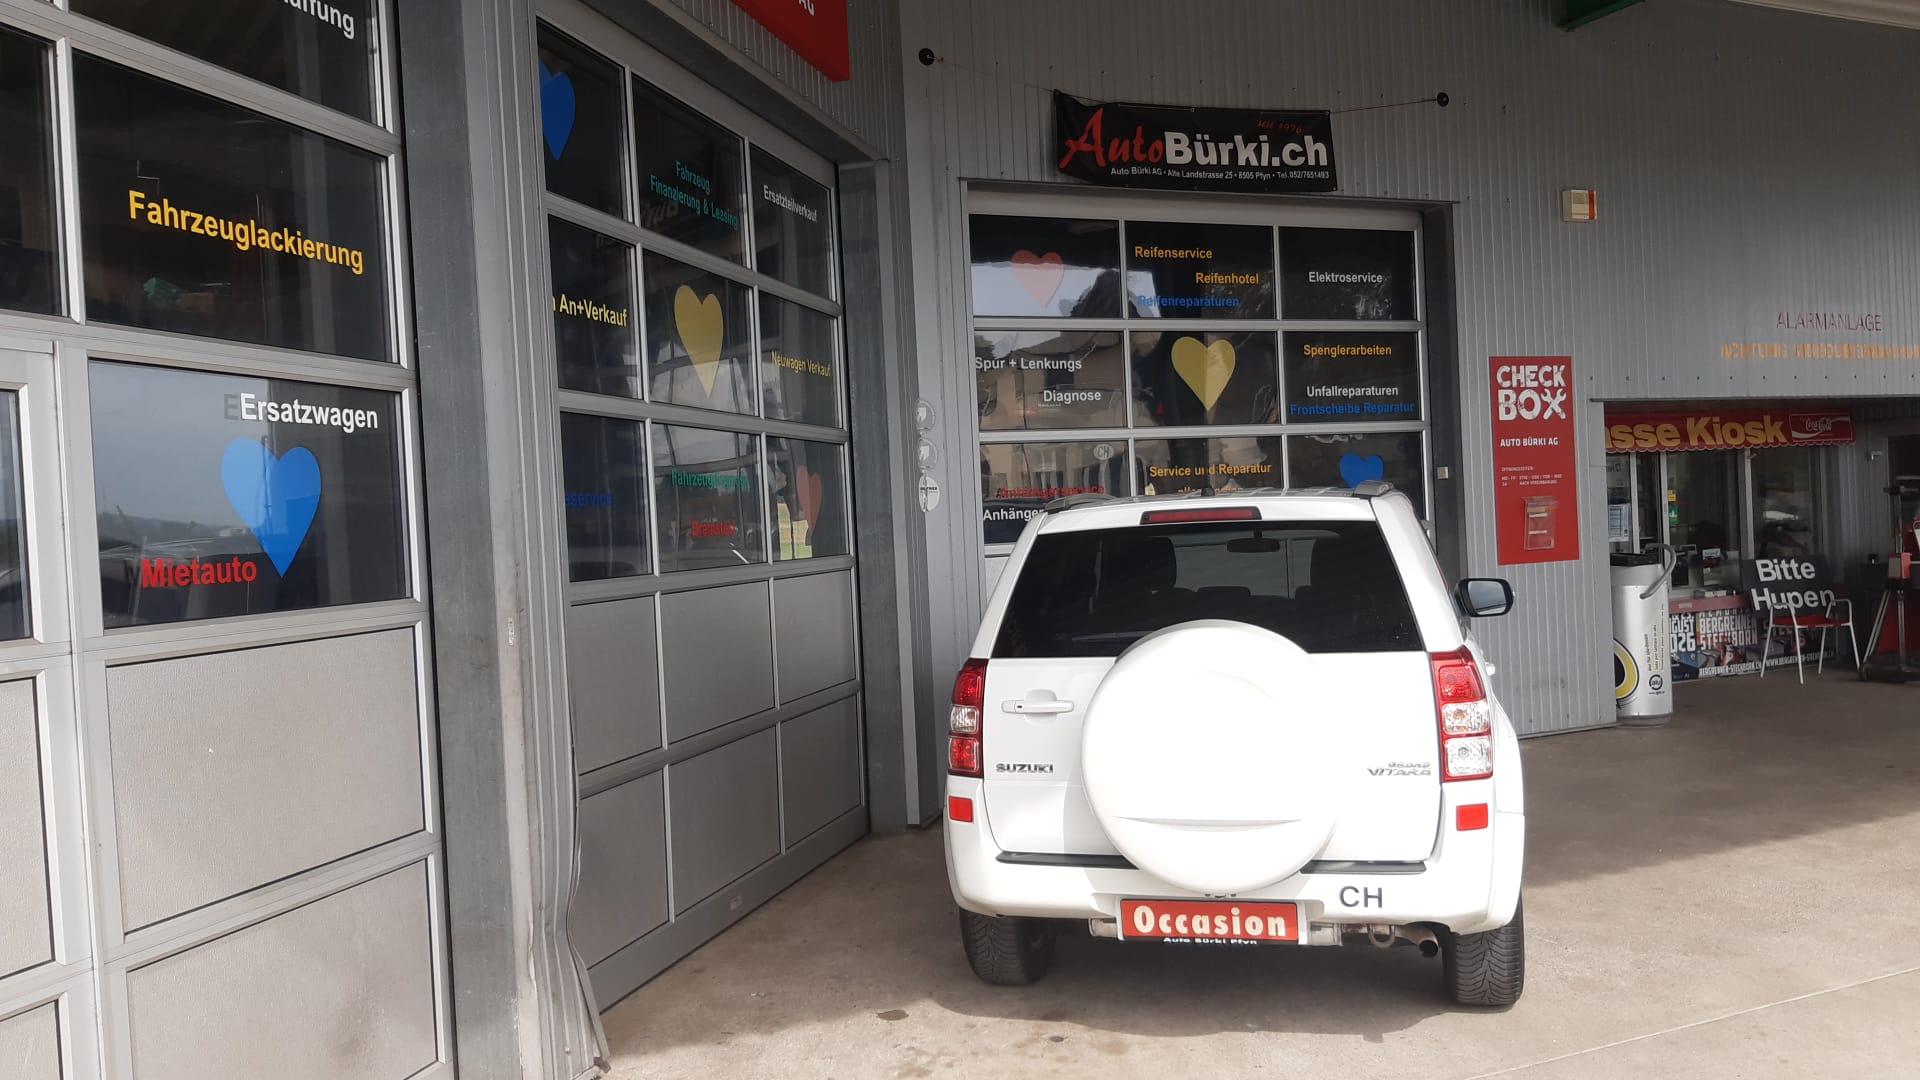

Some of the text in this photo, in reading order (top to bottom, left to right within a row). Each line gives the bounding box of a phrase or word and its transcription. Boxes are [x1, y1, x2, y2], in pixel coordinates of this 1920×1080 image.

[676, 160, 711, 195] Fahrzeug
[1111, 167, 1130, 176] Auto
[1131, 166, 1151, 175] Bürki
[1152, 168, 1162, 176] AG
[1181, 169, 1224, 179] Landstrasse
[1224, 170, 1233, 179] 25
[1255, 170, 1271, 181] Pfyn
[650, 174, 701, 215] Finanzierung
[703, 199, 709, 217] &
[711, 203, 739, 231] Leasing
[763, 184, 818, 223] Ersatzteilverkauf
[128, 190, 364, 275] Fahrzeuglackierung
[1135, 246, 1213, 260] Reifenservice
[1195, 272, 1259, 285] Reifenhotel
[1308, 271, 1383, 284] Elektroservice
[559, 293, 628, 328] An+Verkauf
[1137, 294, 1241, 308] Reifenreparaturen
[1776, 311, 1882, 332] ALARMANLAGE
[1303, 344, 1392, 358] Spenglerarbeiten
[771, 351, 832, 377] Neuwagen Verkauf
[975, 357, 1083, 372] Spur + Lenkungs
[1496, 365, 1567, 387] CHECK
[1043, 388, 1102, 405] Diagnose
[1306, 385, 1399, 398] Unfallreparaturen
[240, 392, 379, 434] Ersatzwagen
[1289, 401, 1415, 417] Frontscheibe Reparatur
[1497, 388, 1567, 420] BOX
[1685, 415, 1788, 446] Kiosk
[1500, 437, 1559, 447] AUTO BÜRKI AG
[1149, 465, 1191, 477] Service
[1218, 462, 1272, 477] Reparatur
[141, 556, 258, 588] Mietauto
[1755, 558, 1816, 582] Bitte
[1750, 587, 1836, 611] Hupen
[995, 763, 1055, 773] SUZUKI
[1366, 767, 1432, 776] VITARA
[1339, 886, 1383, 909] CH
[1132, 905, 1287, 939] Occasion
